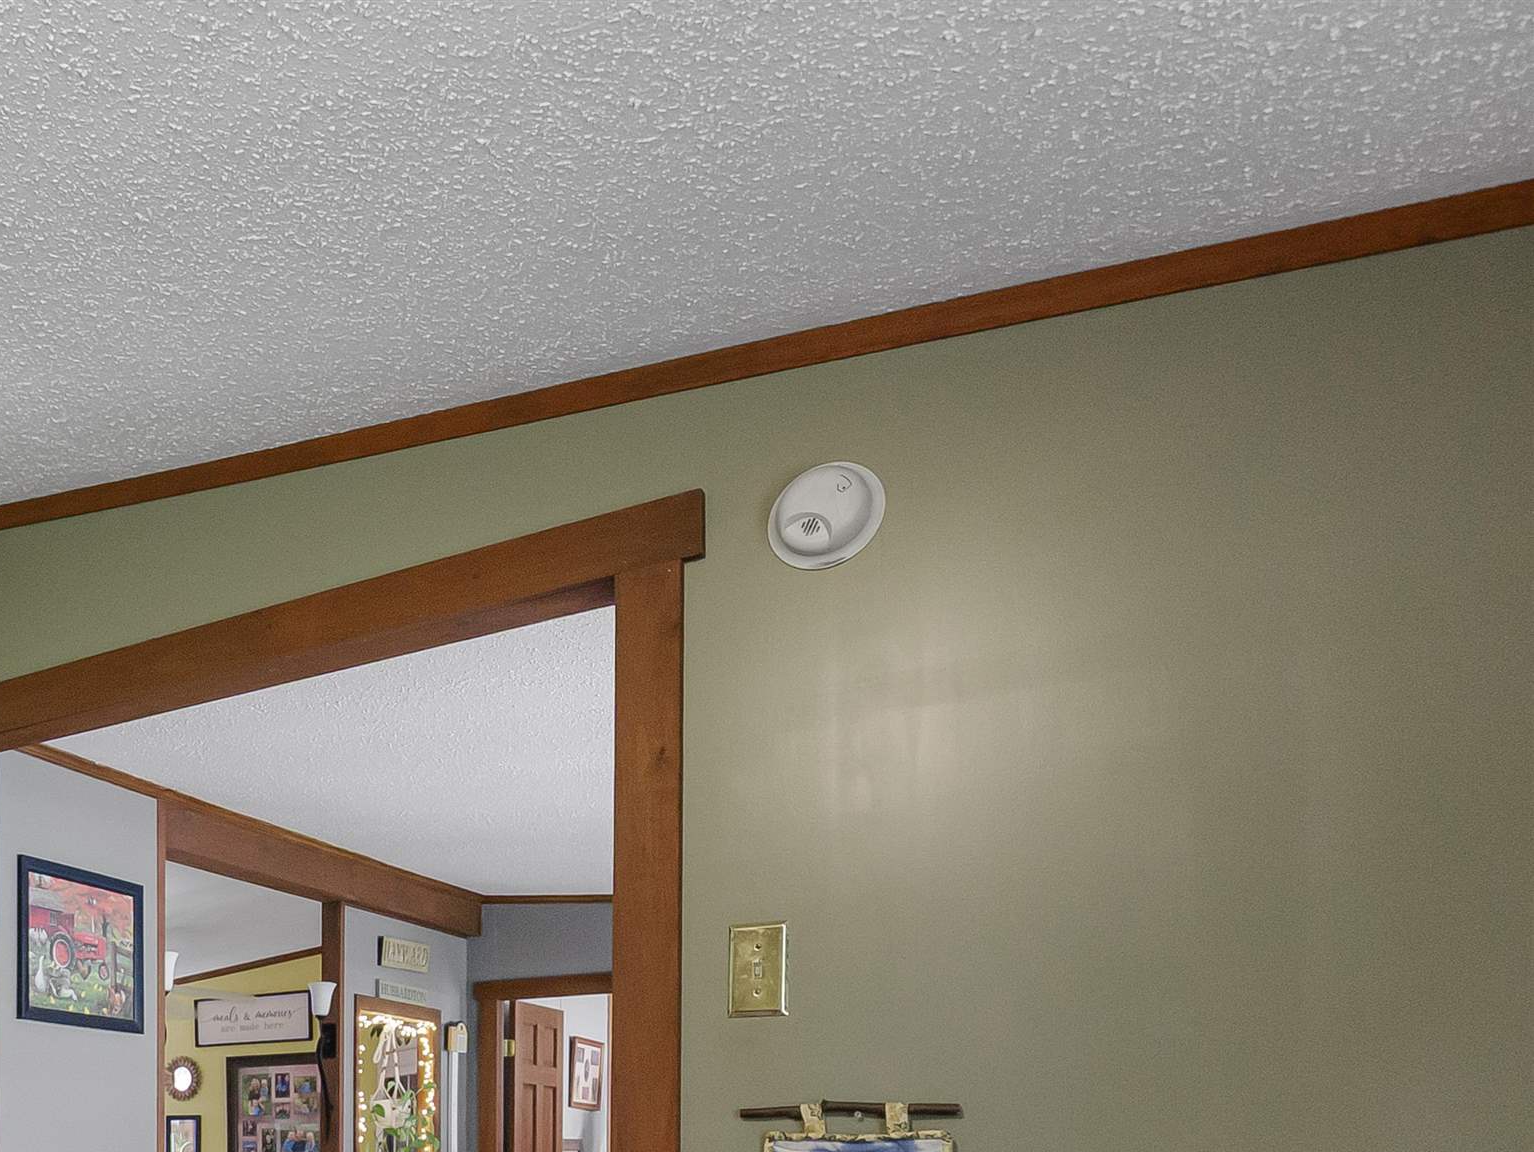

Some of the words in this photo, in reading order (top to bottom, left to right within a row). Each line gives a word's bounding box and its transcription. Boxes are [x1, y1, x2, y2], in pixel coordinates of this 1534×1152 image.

[212, 1006, 238, 1023] meals
[243, 1012, 251, 1021] &
[255, 1008, 296, 1019] memories
[264, 1022, 284, 1030] here
